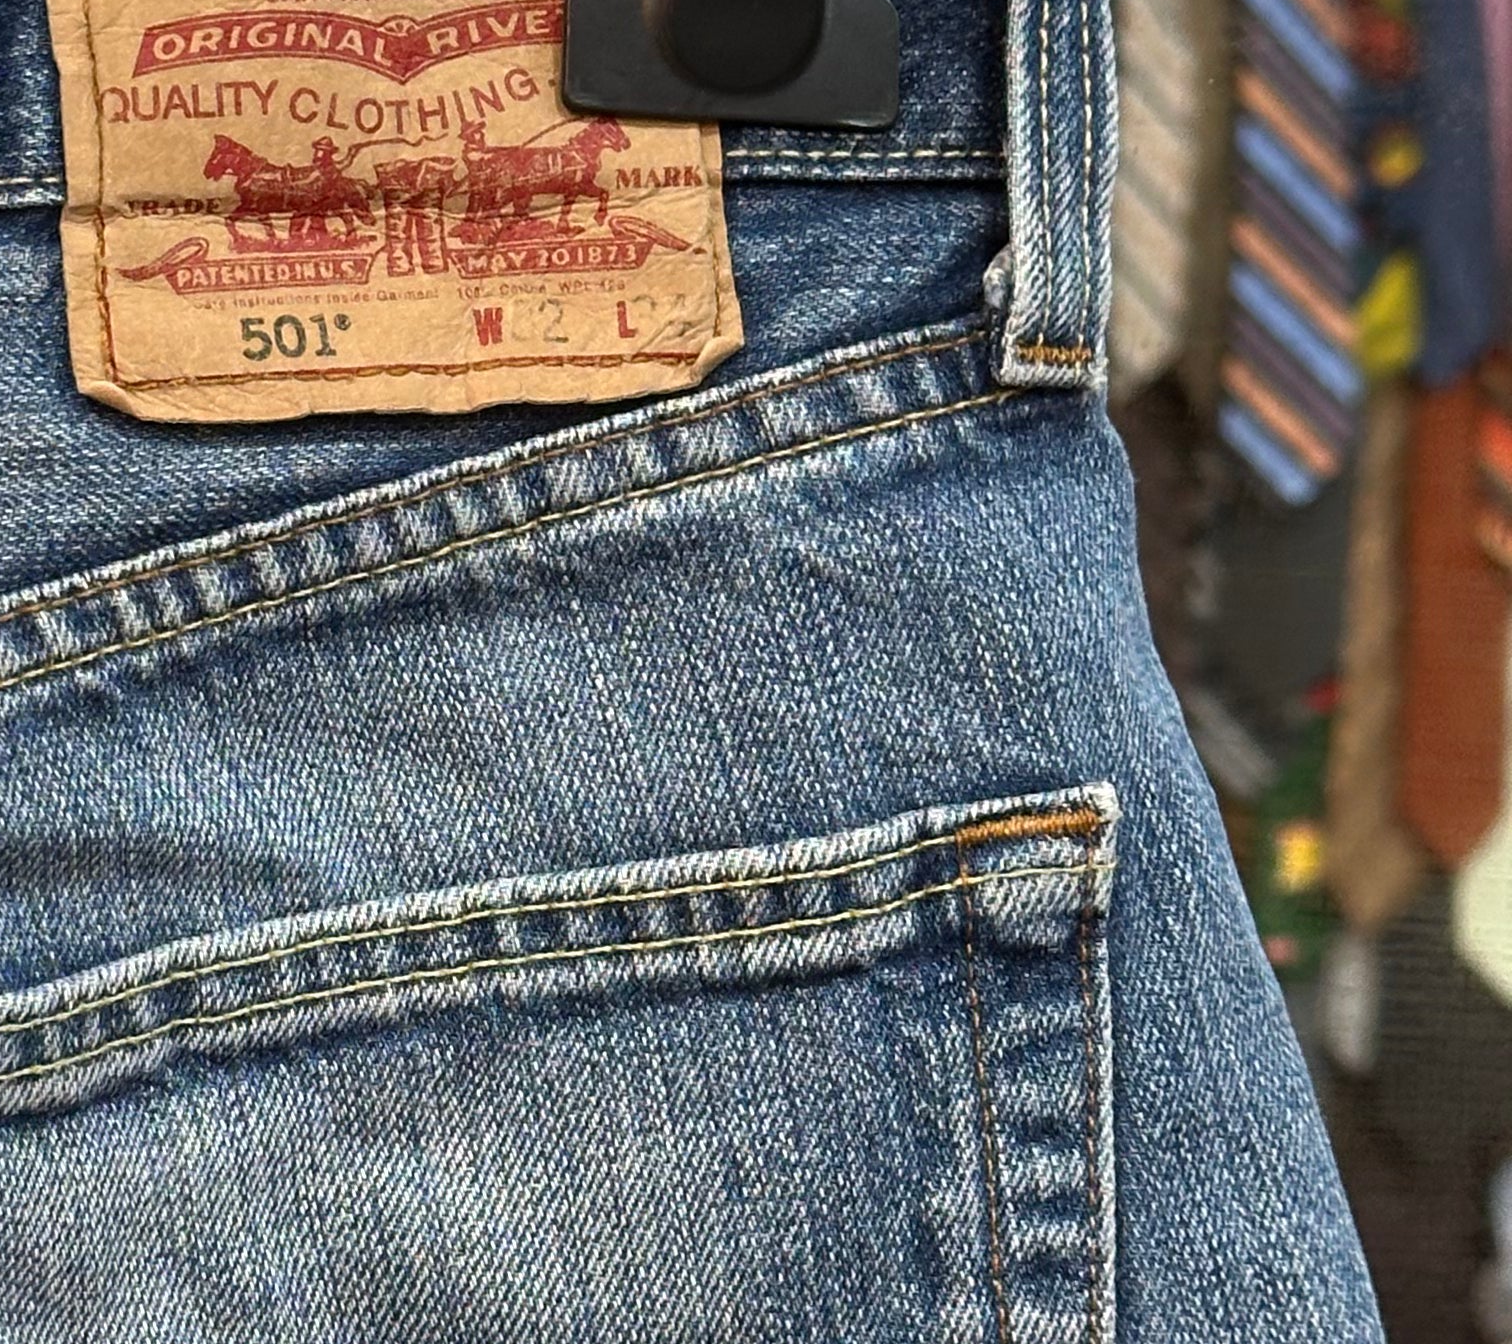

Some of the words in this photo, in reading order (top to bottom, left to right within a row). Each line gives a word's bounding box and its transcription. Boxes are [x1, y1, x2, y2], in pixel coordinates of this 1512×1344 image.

[152, 21, 393, 68] ORIGINAL
[426, 7, 565, 55] RIVE
[100, 79, 279, 124] QUALITY
[289, 67, 540, 134] CLOTHING
[615, 165, 703, 190] MARK
[125, 197, 223, 216] TRADE
[176, 263, 289, 288] PATENTED
[468, 251, 527, 273] MAY
[578, 244, 637, 265] 1873
[472, 306, 503, 346] W
[616, 299, 637, 338] L
